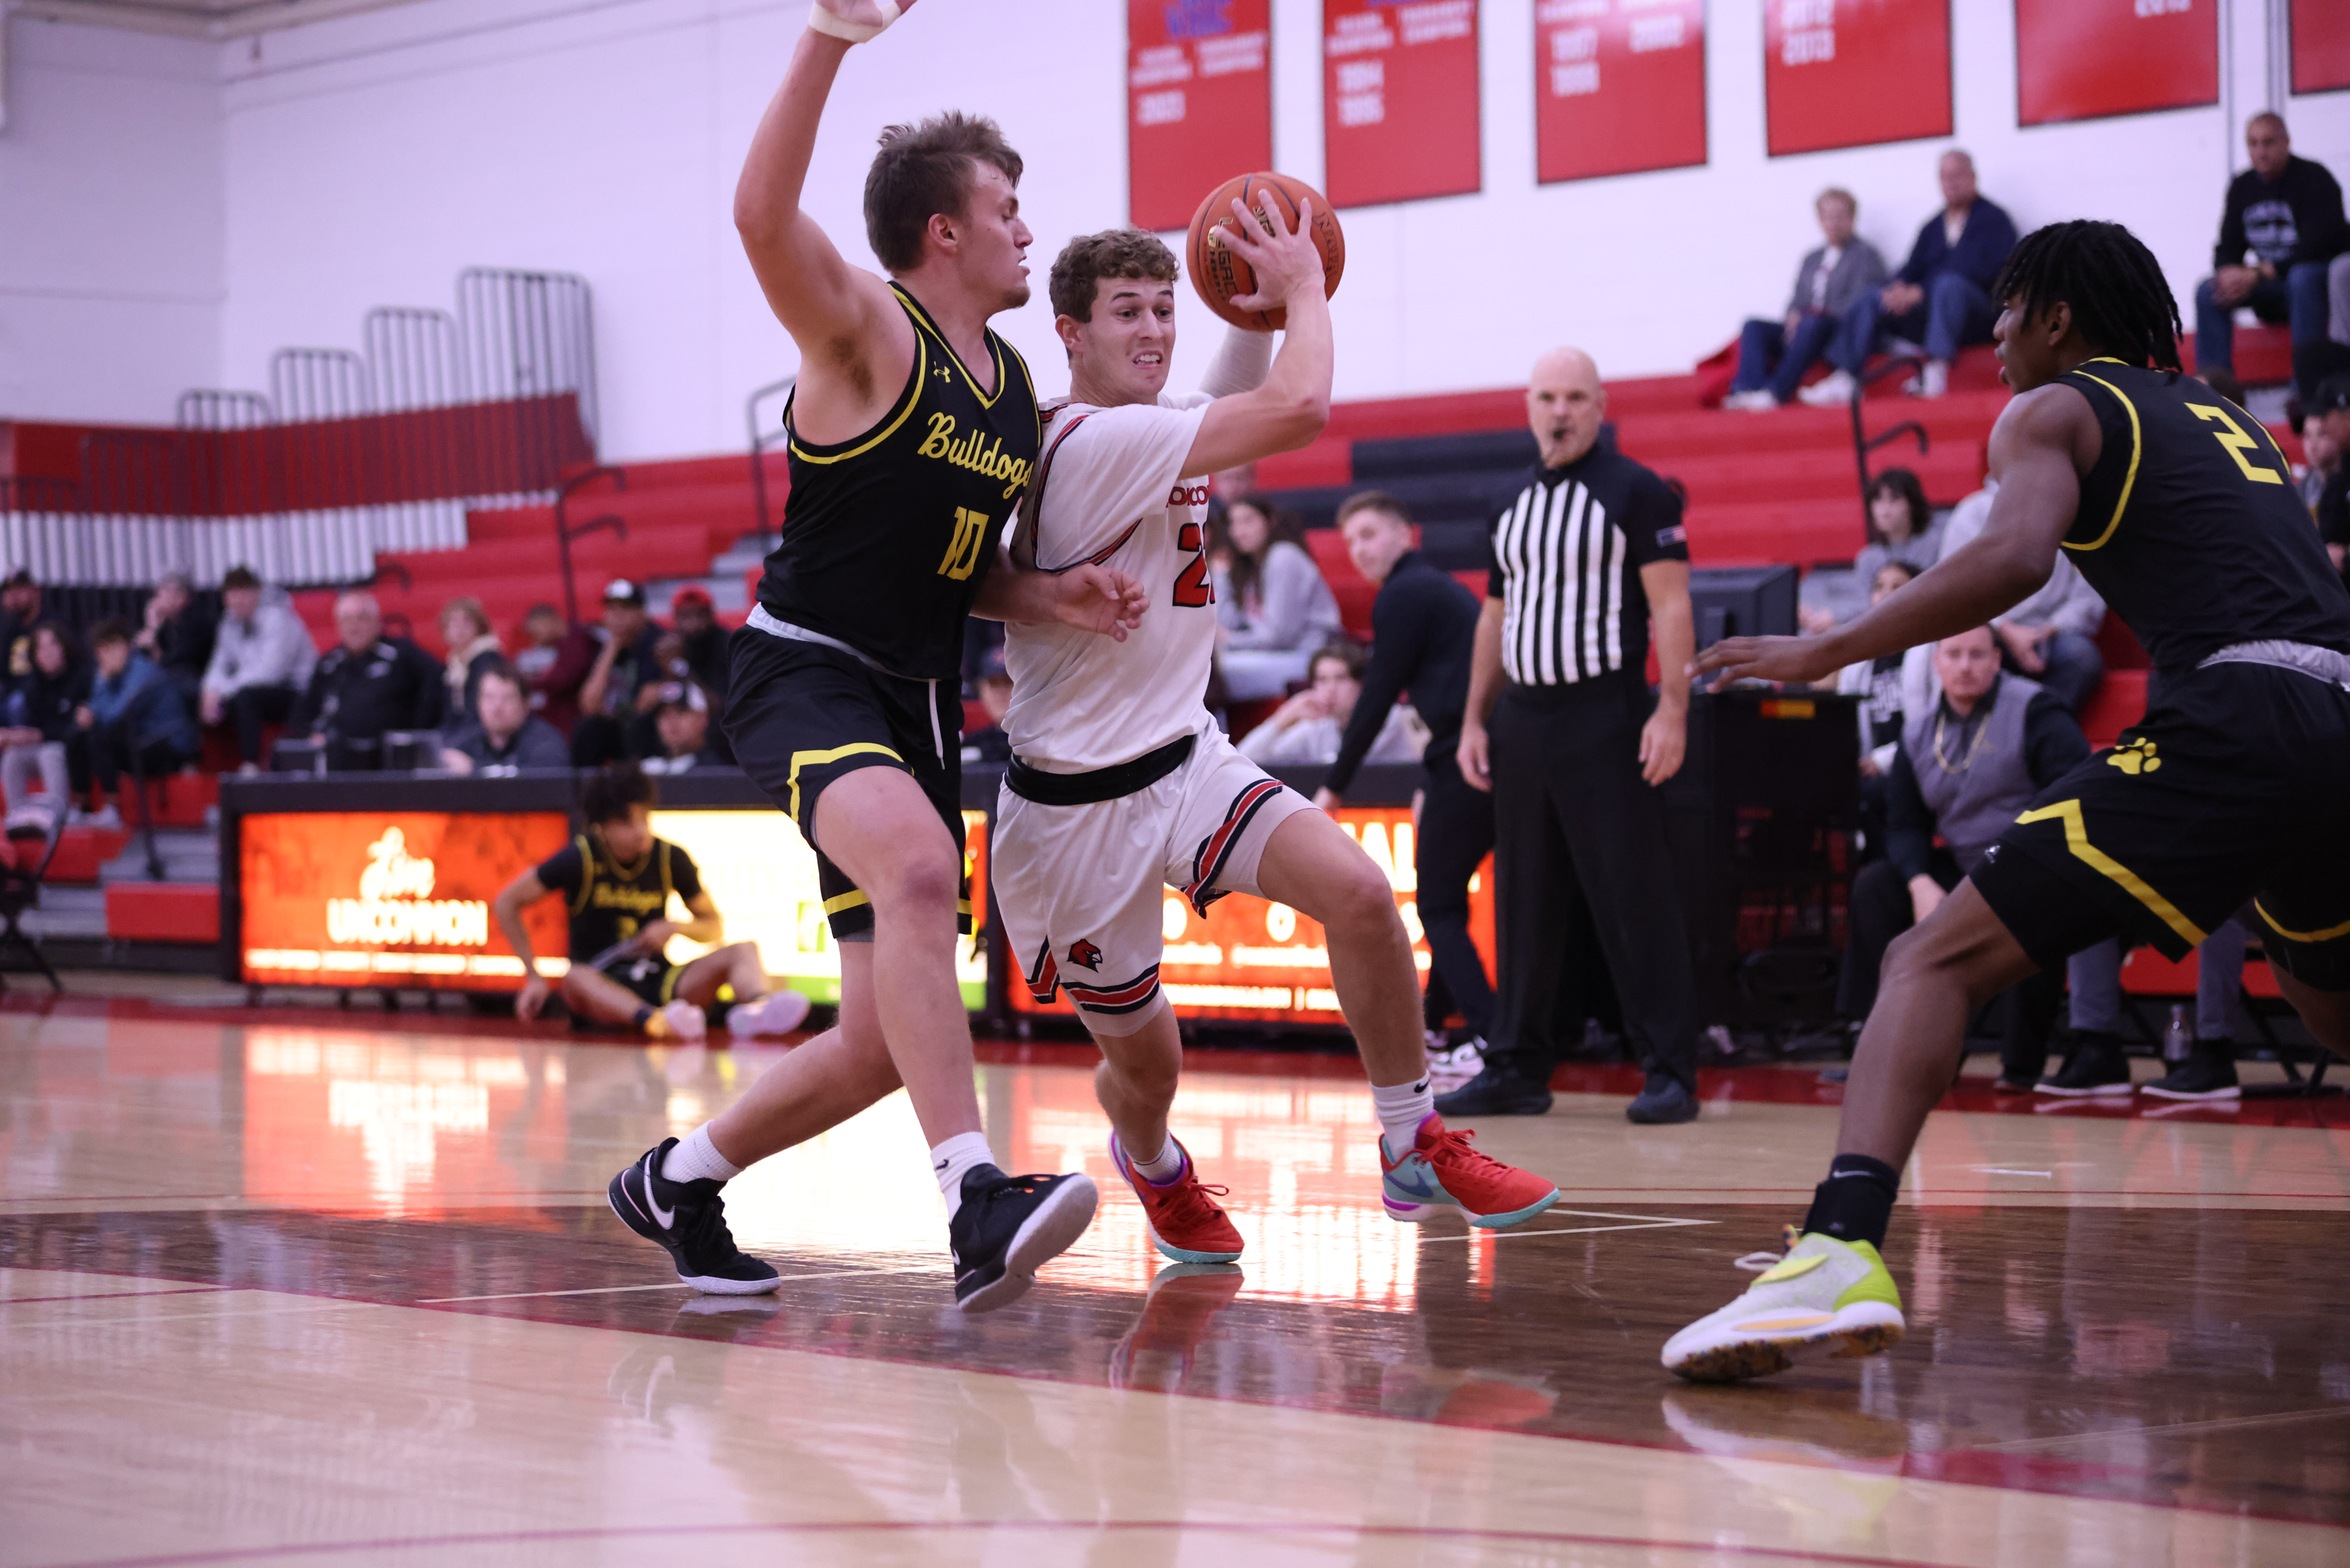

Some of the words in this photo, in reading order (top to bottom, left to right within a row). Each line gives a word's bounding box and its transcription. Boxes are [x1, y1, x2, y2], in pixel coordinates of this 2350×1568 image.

[917, 411, 1034, 500] Bulldogs
[2184, 402, 2284, 485] 2
[937, 506, 990, 581] 10
[1172, 522, 1216, 608] 2
